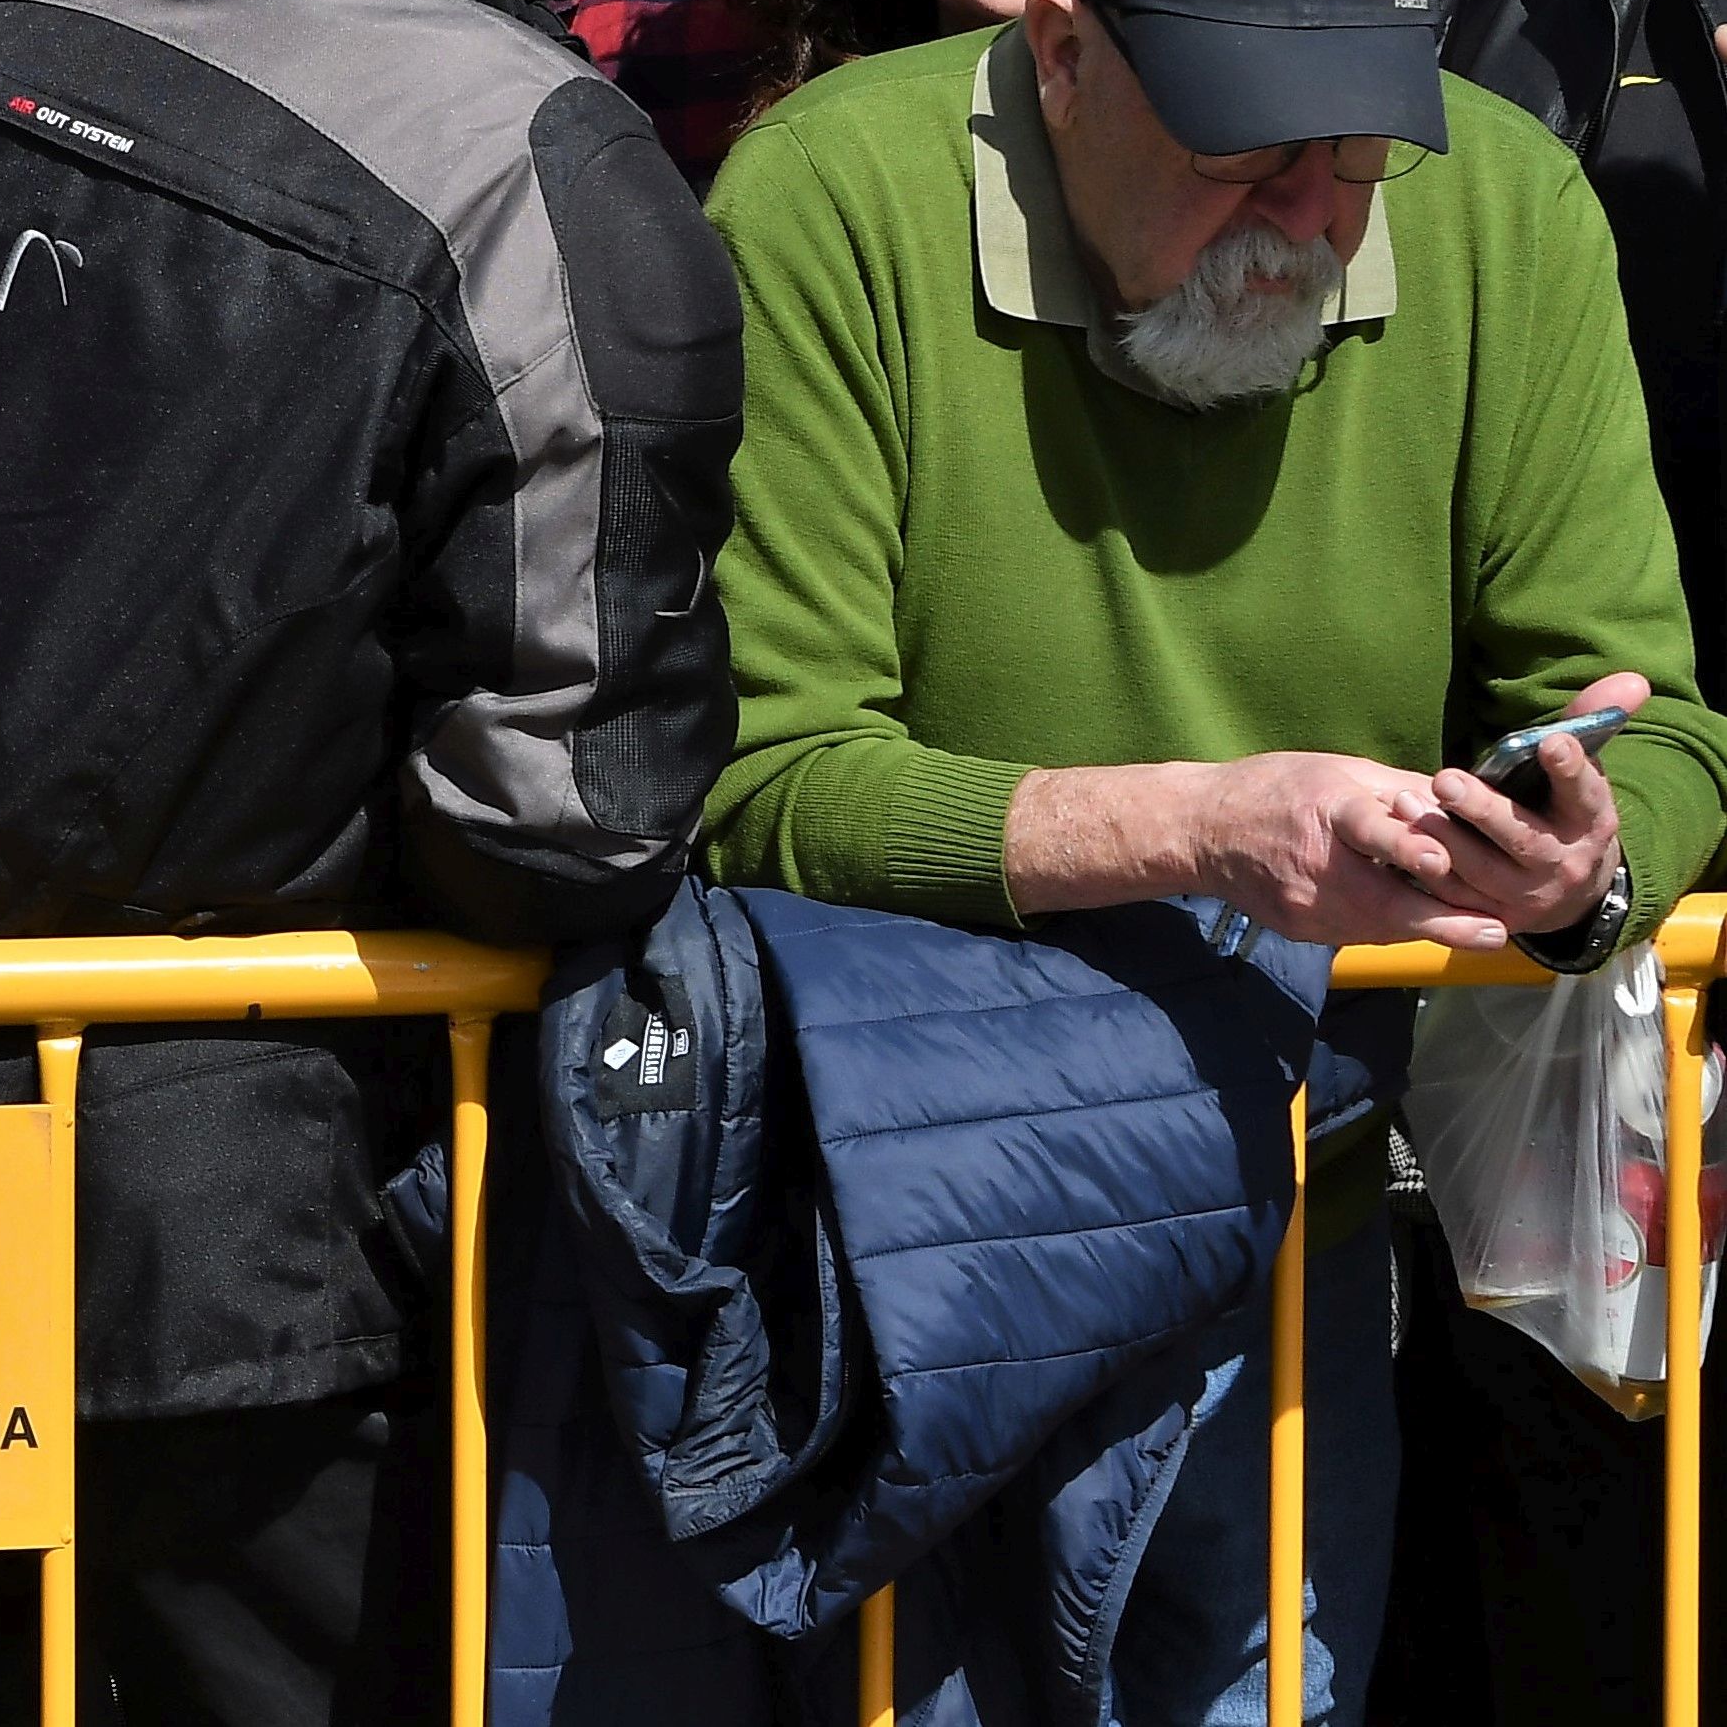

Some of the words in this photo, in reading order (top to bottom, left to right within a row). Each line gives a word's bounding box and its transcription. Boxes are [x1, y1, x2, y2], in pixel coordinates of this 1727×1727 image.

[8, 95, 37, 115] AIR
[36, 107, 70, 129] OUT
[69, 120, 135, 153] SYSTEM
